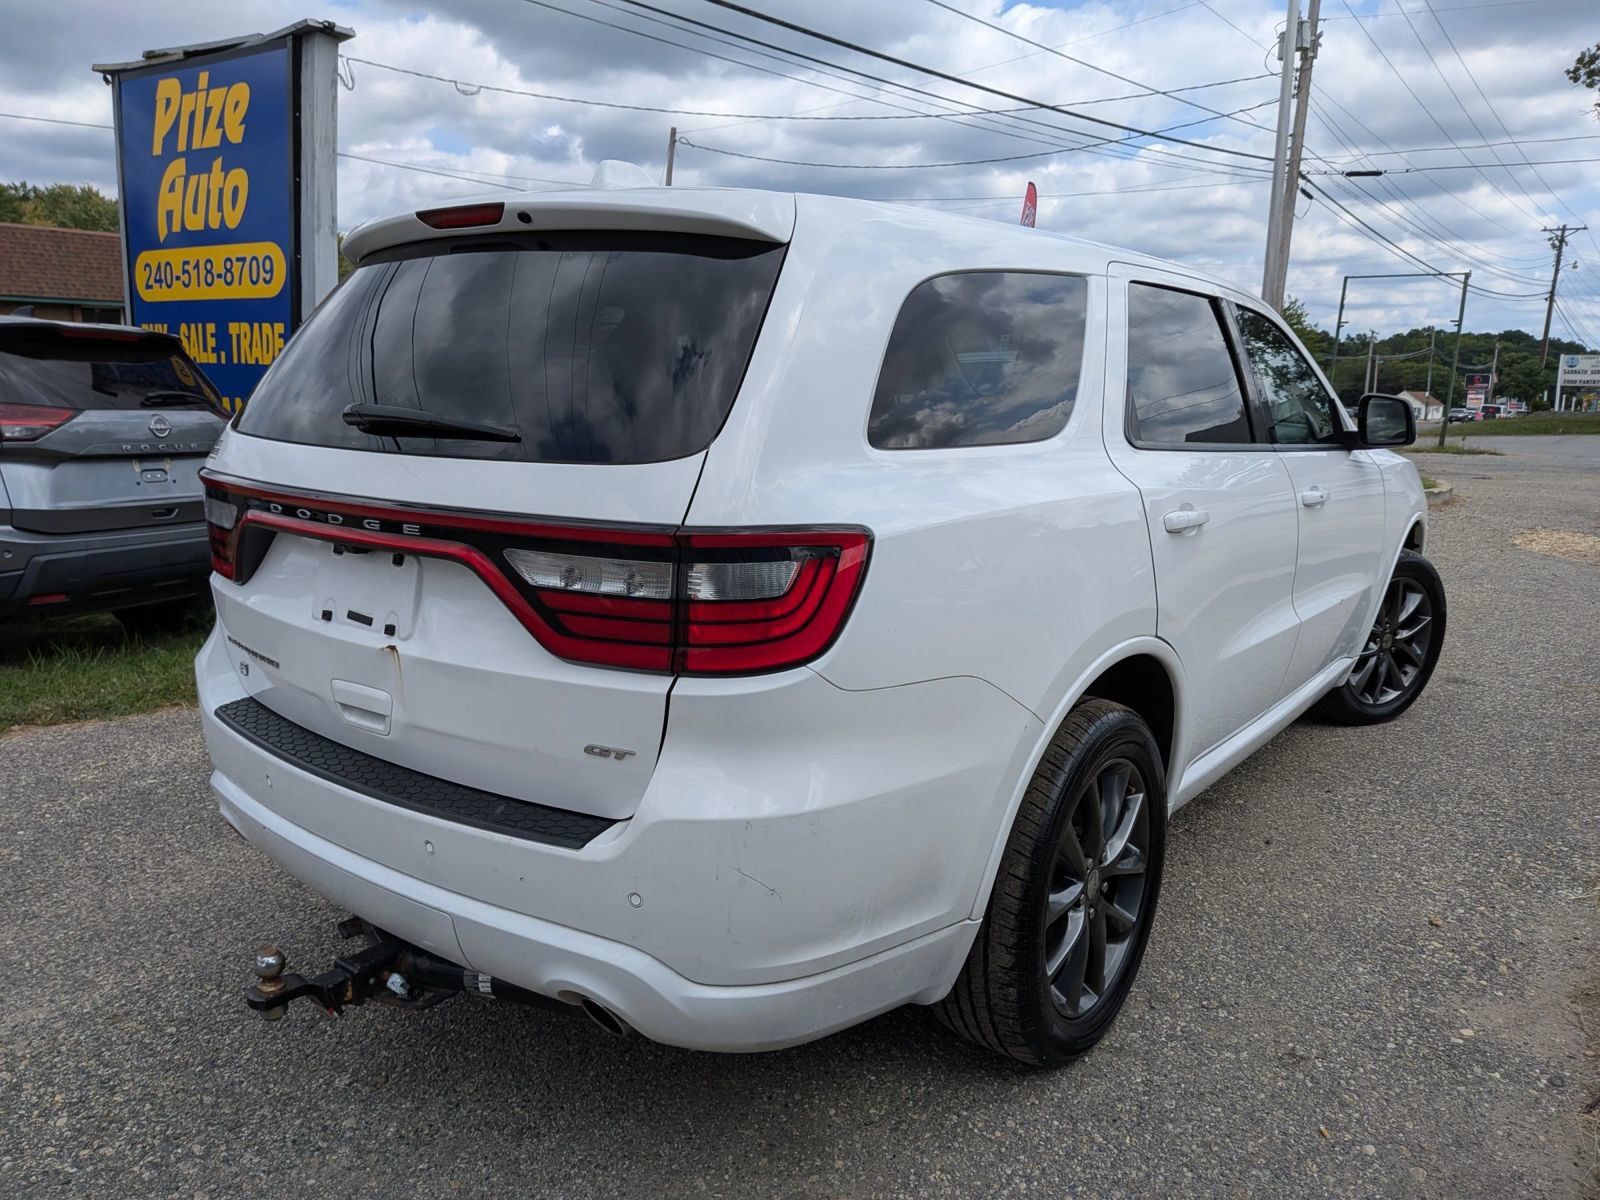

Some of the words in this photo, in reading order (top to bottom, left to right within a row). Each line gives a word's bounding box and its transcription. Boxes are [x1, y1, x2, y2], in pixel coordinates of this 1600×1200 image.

[152, 71, 250, 156] Prize
[157, 156, 249, 244] Auto
[143, 255, 275, 290] 240-518-8709
[229, 322, 285, 365] TRADE
[269, 503, 422, 536] DODGE
[583, 744, 637, 761] GT
